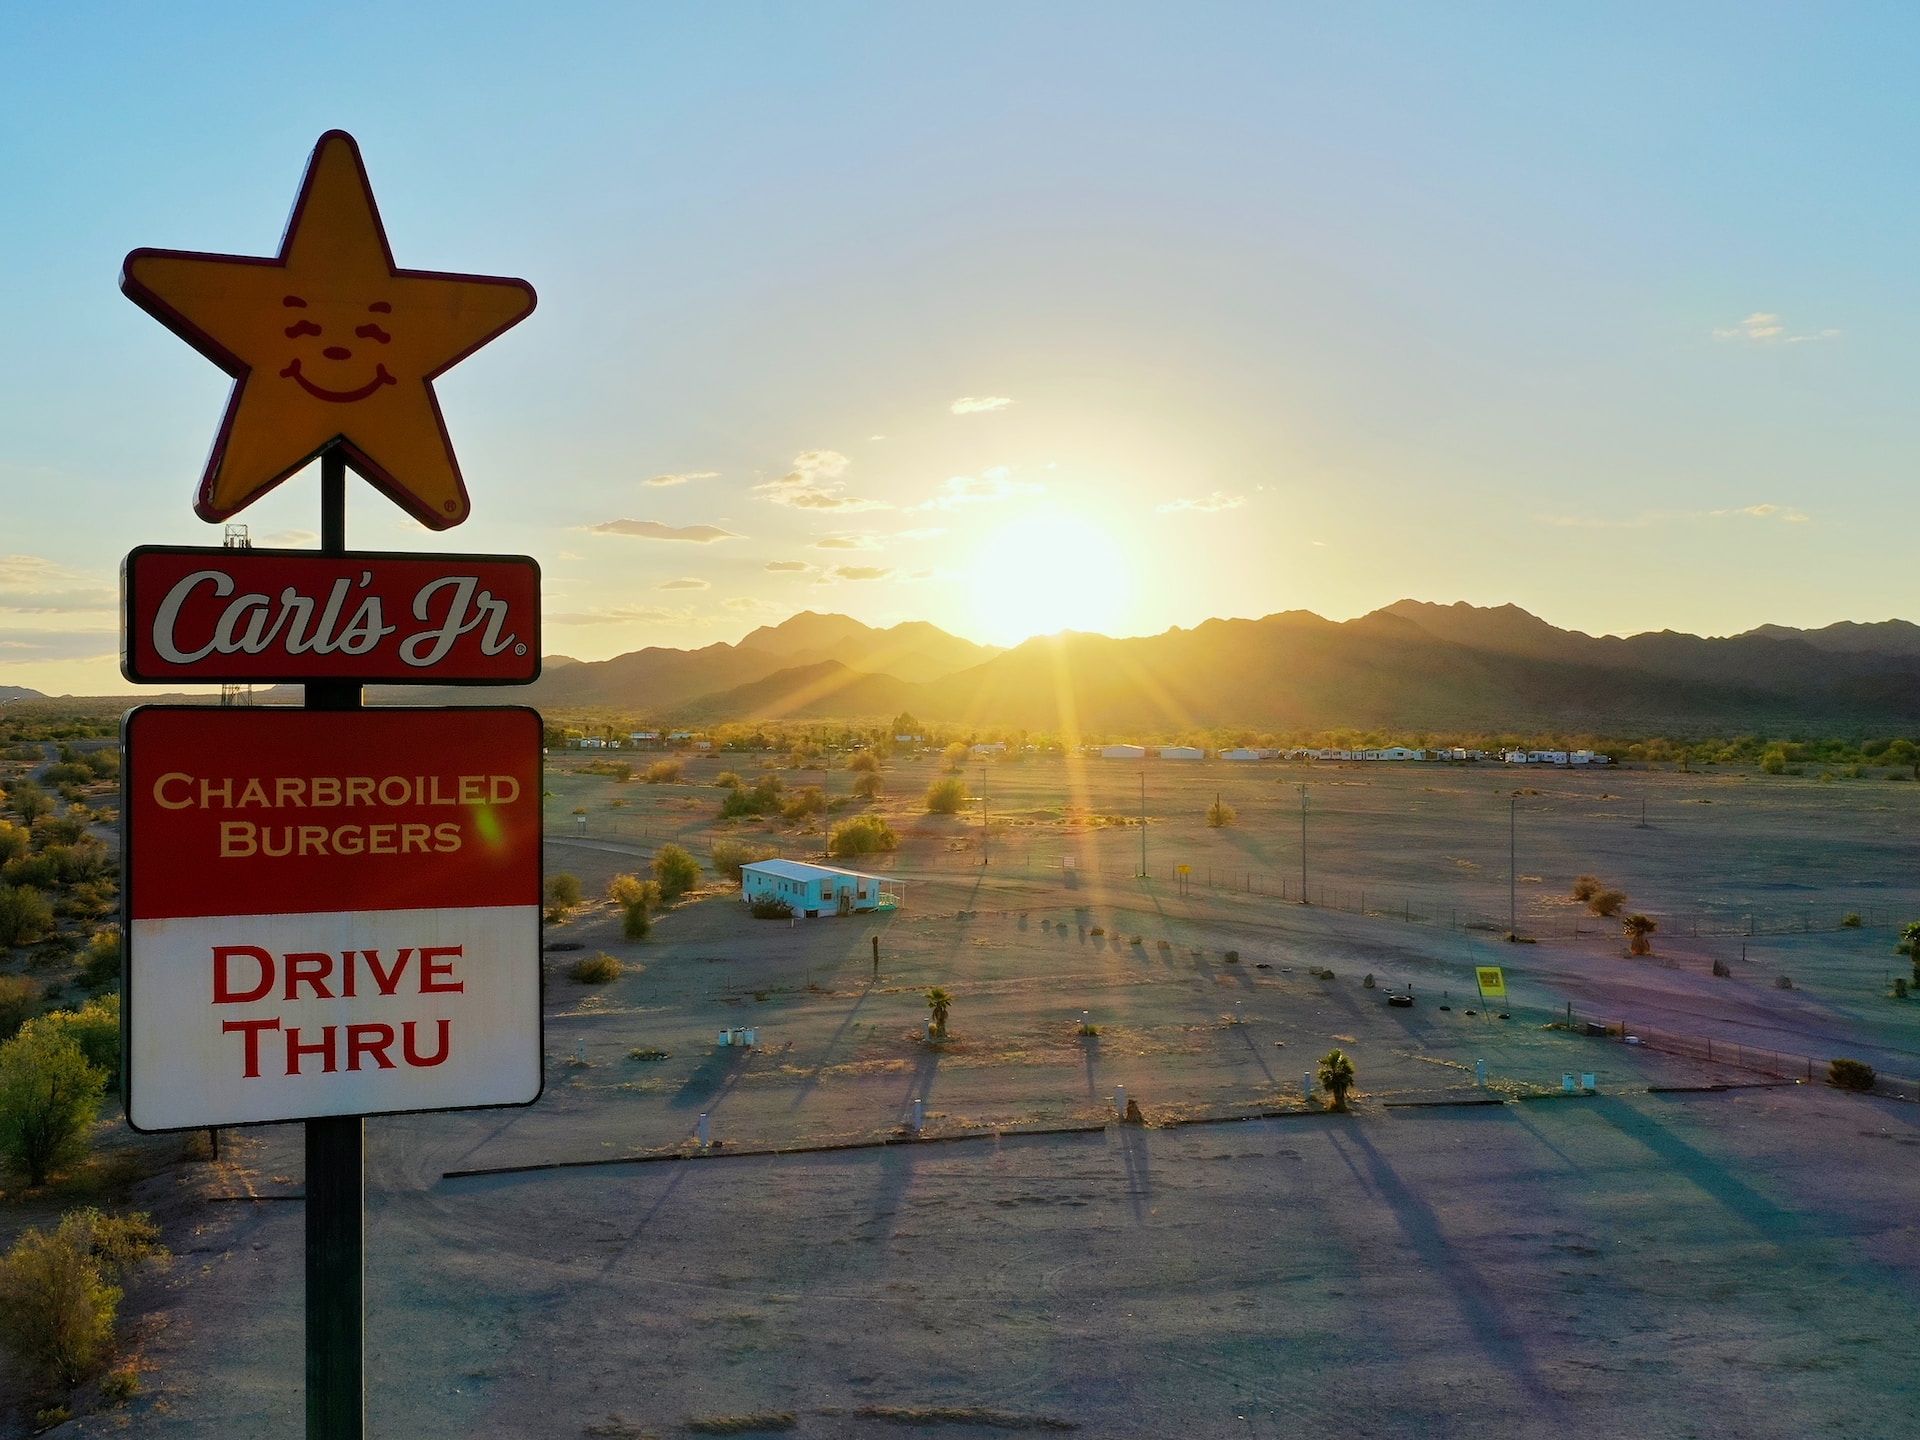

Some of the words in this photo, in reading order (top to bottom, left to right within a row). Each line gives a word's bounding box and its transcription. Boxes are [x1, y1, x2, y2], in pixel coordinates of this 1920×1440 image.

[152, 570, 396, 664] Carl's
[153, 772, 521, 809] CHARBROILED
[219, 820, 463, 858] BURGERS
[210, 944, 464, 1004] DRIVE
[222, 1016, 451, 1079] THRU
